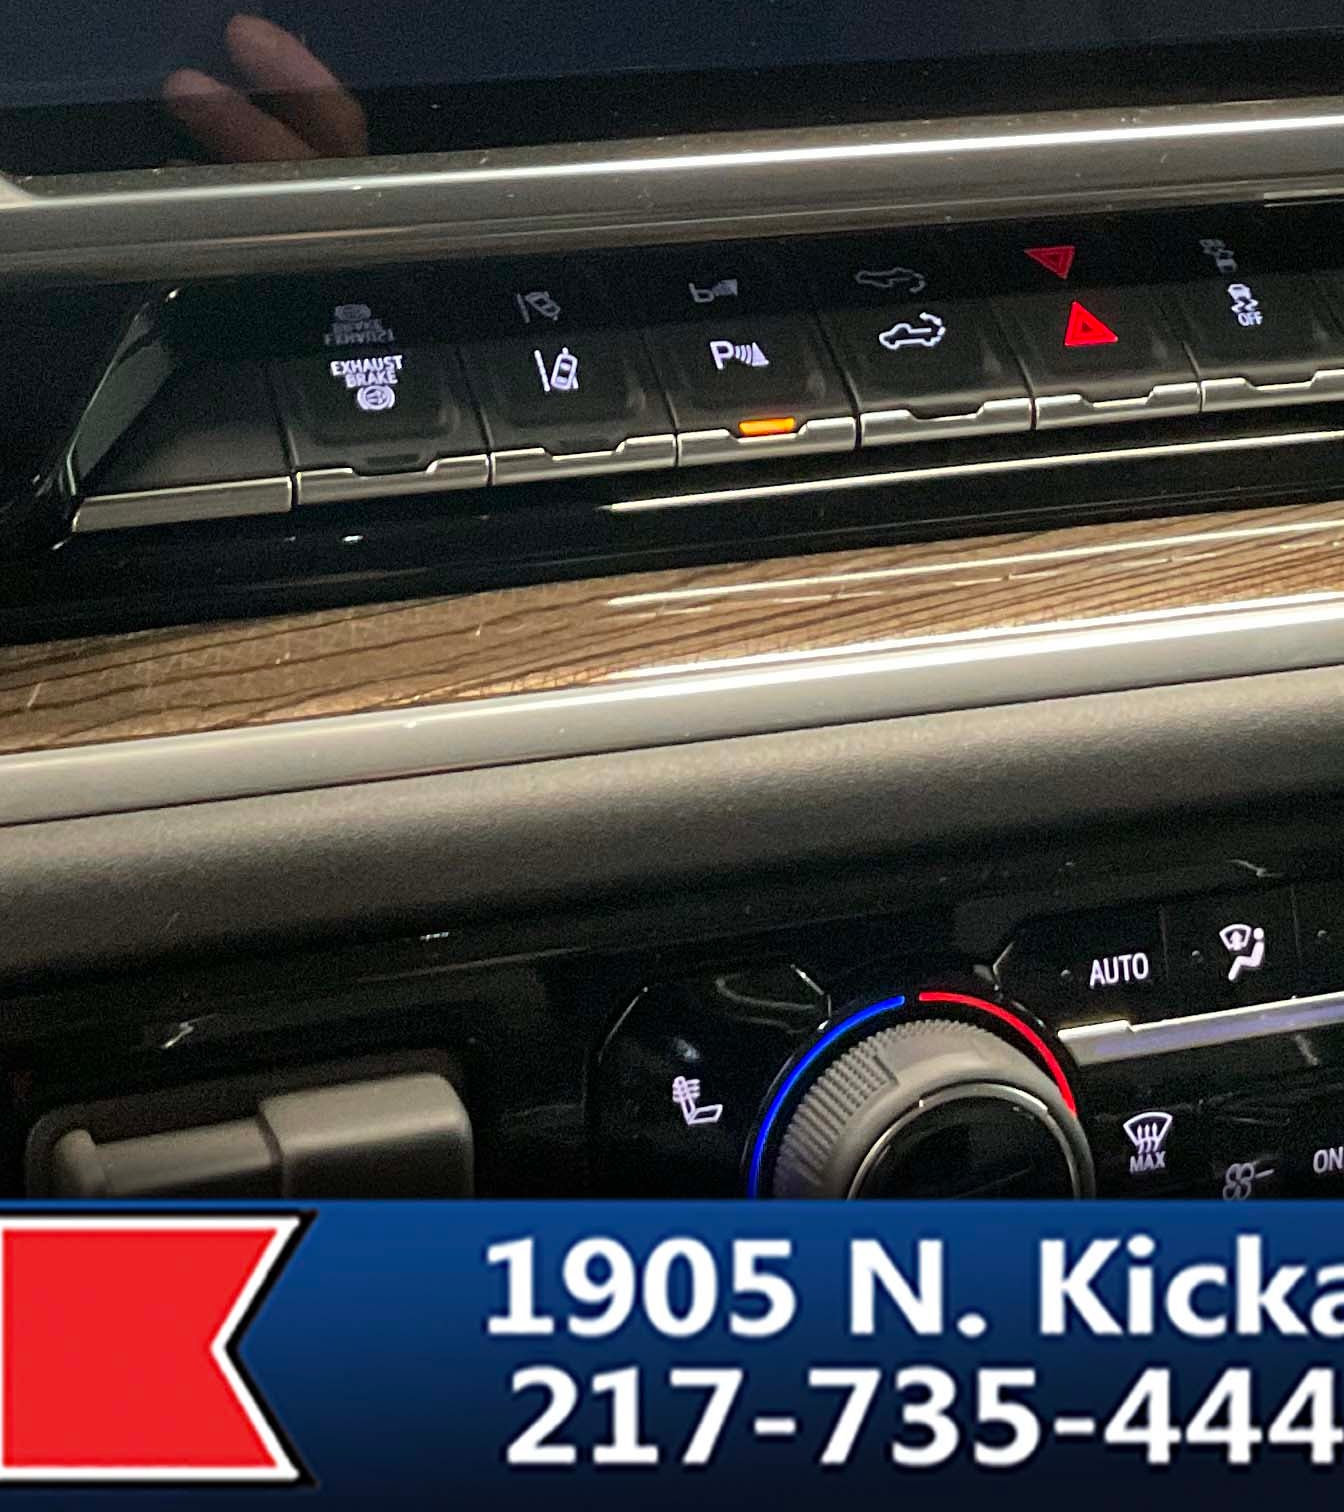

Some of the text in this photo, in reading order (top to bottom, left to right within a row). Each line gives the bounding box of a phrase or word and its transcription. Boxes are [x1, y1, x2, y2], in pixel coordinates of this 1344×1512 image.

[1237, 310, 1263, 327] OFF
[329, 354, 403, 376] EXHAUST
[345, 369, 398, 388] BRAKE
[1089, 952, 1149, 987] AUTO
[1129, 1151, 1167, 1173] MAX
